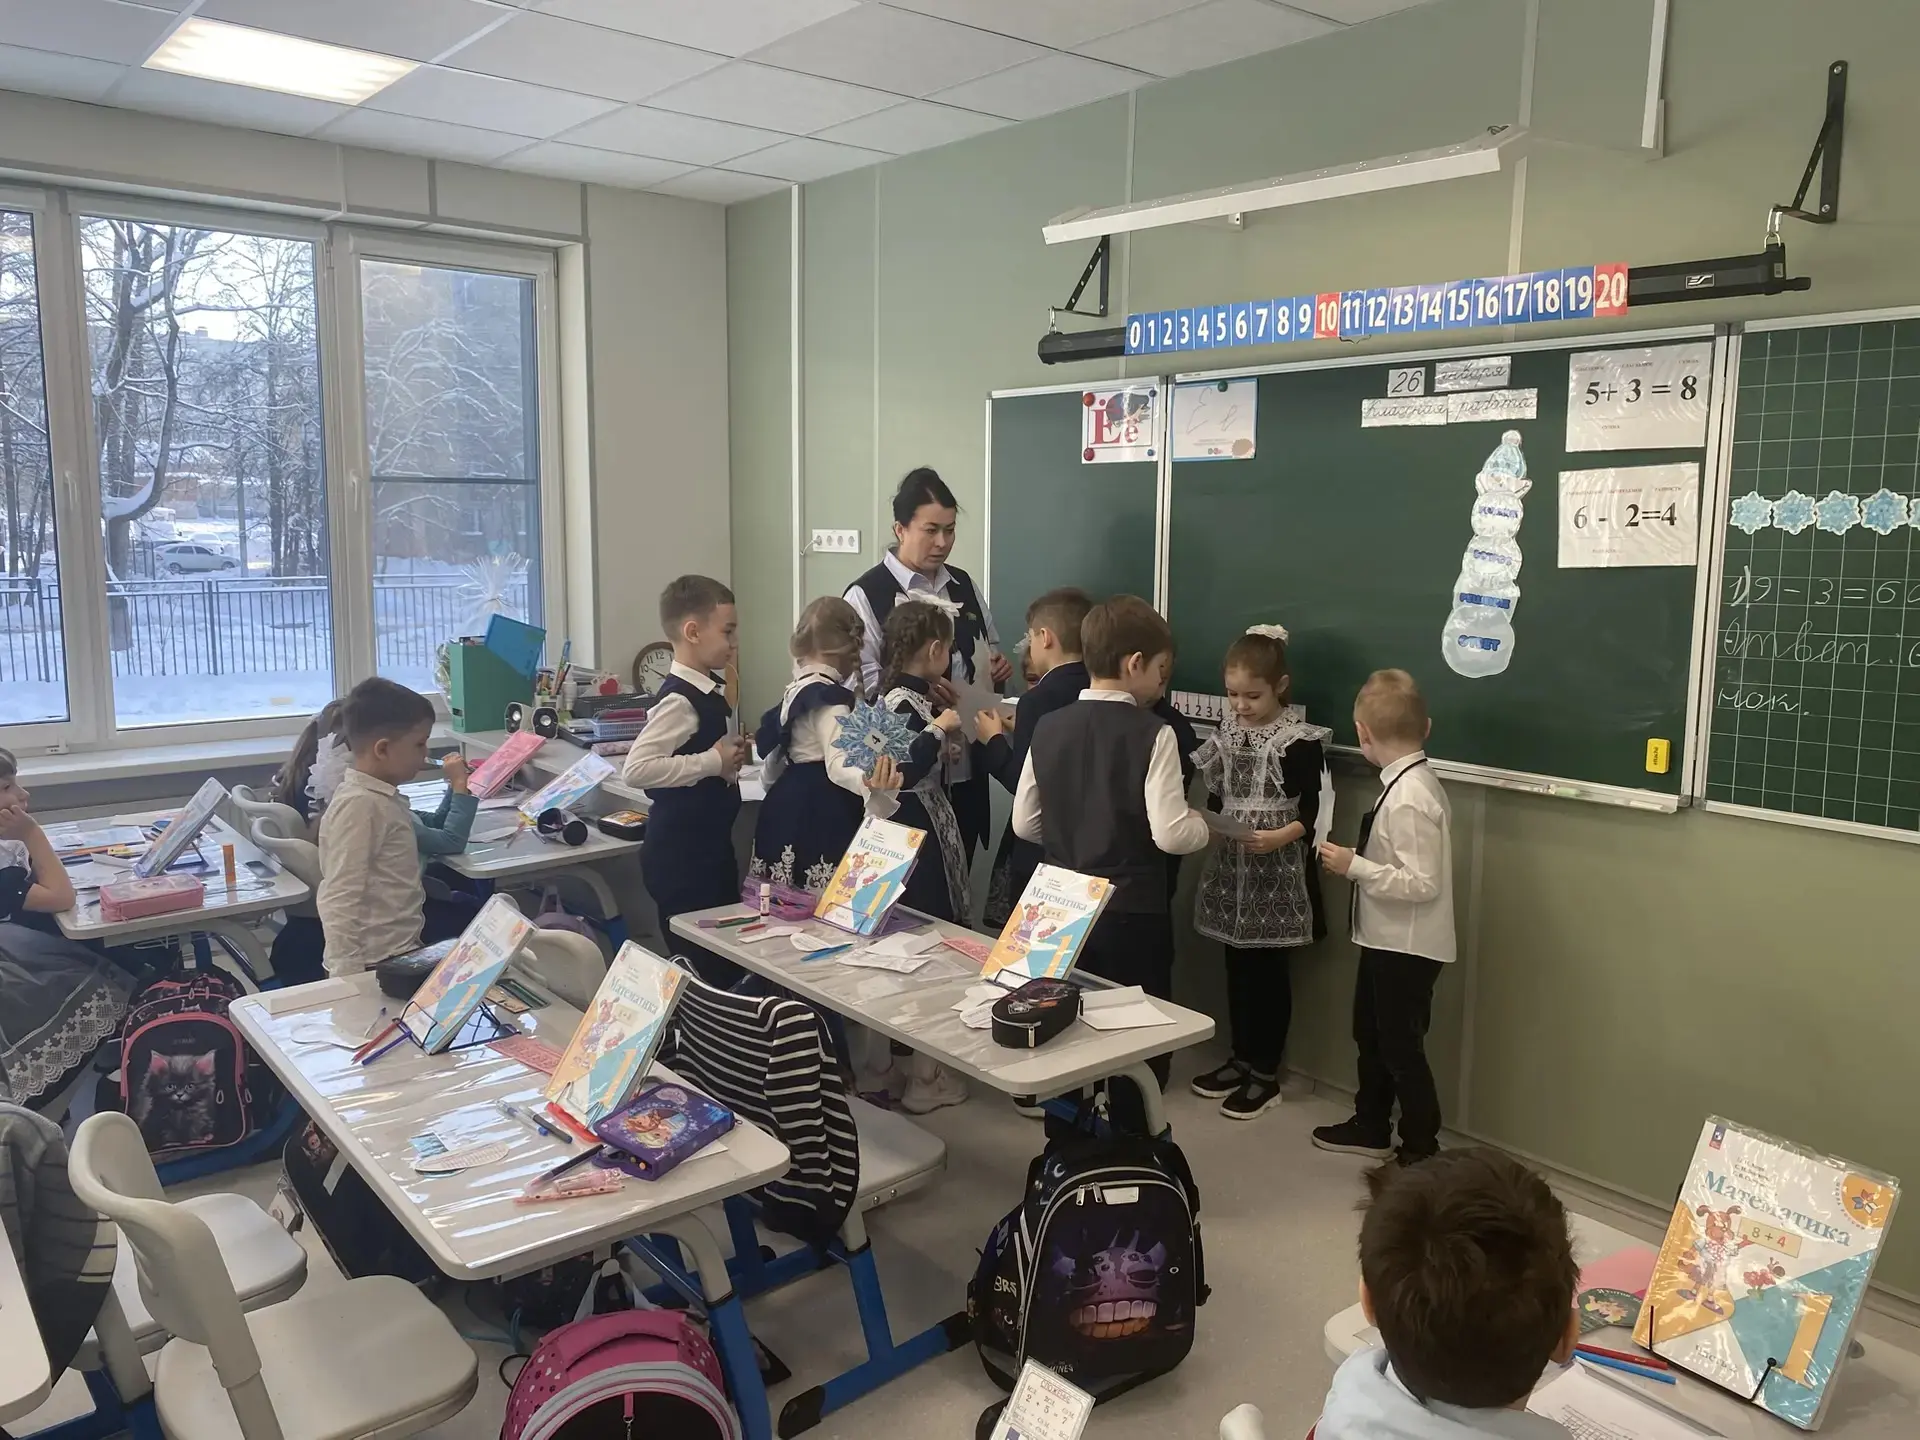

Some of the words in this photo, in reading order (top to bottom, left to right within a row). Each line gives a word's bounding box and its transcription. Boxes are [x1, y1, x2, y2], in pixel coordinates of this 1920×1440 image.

[1130, 321, 1141, 348] 0
[1148, 319, 1155, 346] 1
[1163, 318, 1172, 345] 2
[1180, 316, 1190, 344] 3
[1197, 314, 1209, 342] 4
[1216, 312, 1227, 341] 5
[1235, 310, 1247, 339] 6
[1255, 308, 1269, 337] 7
[1277, 306, 1290, 335] 8
[1298, 303, 1312, 333] 9
[1318, 301, 1338, 331] 10
[1342, 298, 1360, 329] 11
[1367, 296, 1386, 327] 12
[1393, 294, 1414, 325] 13
[1420, 291, 1442, 324] 14
[1447, 288, 1469, 321] 15
[1475, 285, 1499, 319] 16
[1504, 282, 1528, 316] 17
[1533, 278, 1560, 314] 18
[1565, 275, 1592, 312] 19
[1596, 272, 1626, 309] 20
[1391, 370, 1423, 393] 26
[1626, 379, 1641, 403] 3
[1680, 375, 1697, 400] 8
[1455, 393, 1533, 421] работа
[1573, 505, 1588, 529] 6
[1814, 578, 1834, 605] 3
[1877, 581, 1901, 604] 6
[646, 655, 653, 664] 11
[655, 651, 665, 660] 12
[641, 664, 649, 673] 10
[1185, 703, 1190, 714] 1
[1195, 705, 1201, 716] 2
[1206, 706, 1212, 717] 3
[1217, 708, 1223, 718] 4
[858, 838, 905, 860] Математика
[1030, 886, 1088, 911] Математика
[609, 975, 659, 1015] Математика
[1704, 1169, 1851, 1247] Математика
[1751, 1227, 1761, 1239] 8
[1776, 1235, 1786, 1248] 4
[1770, 1291, 1834, 1391] 1
